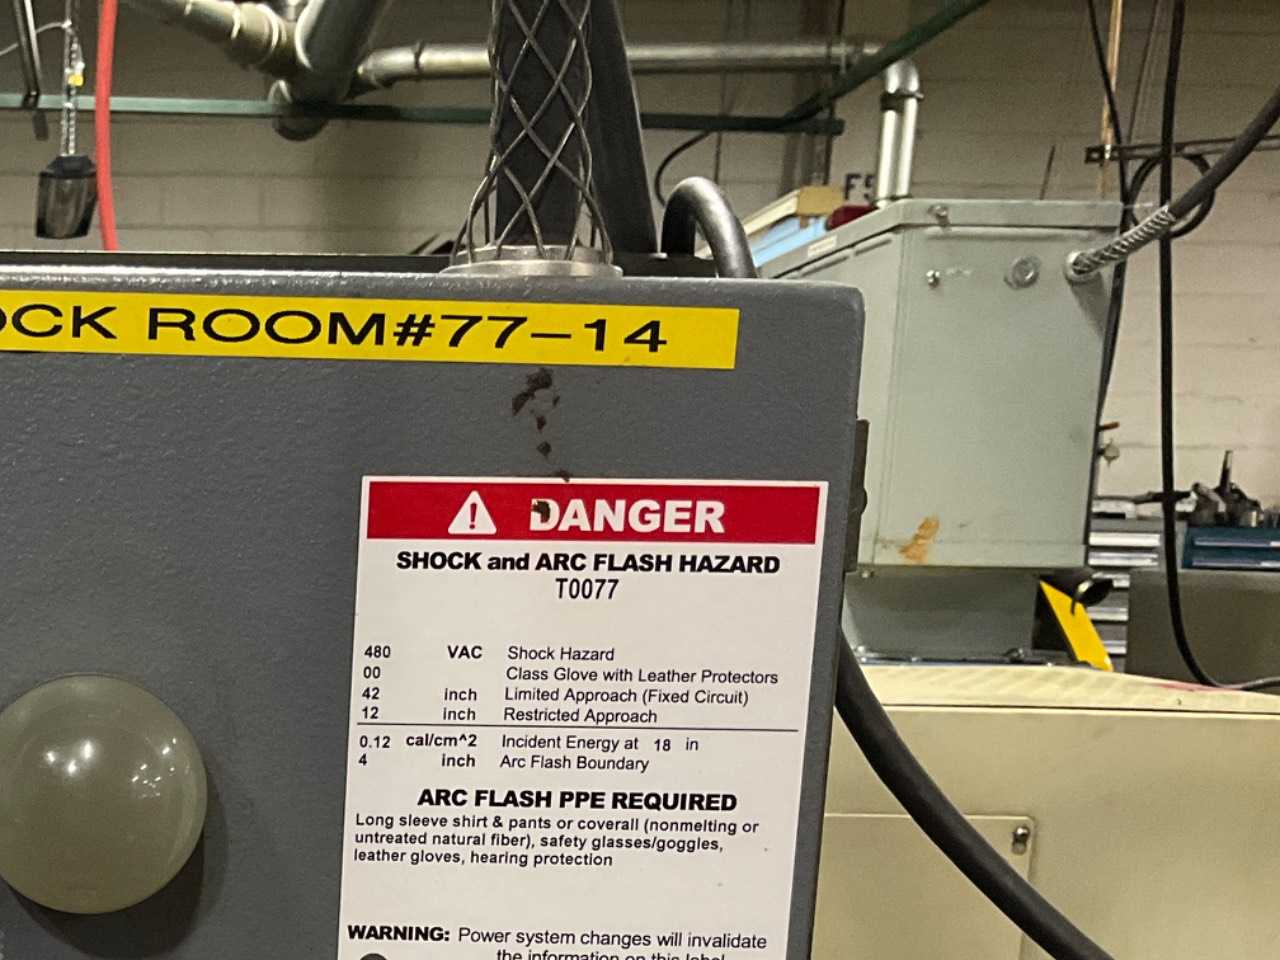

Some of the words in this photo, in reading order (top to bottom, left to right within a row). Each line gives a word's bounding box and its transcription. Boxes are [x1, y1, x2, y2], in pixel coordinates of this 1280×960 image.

[148, 306, 667, 353] ROOM#77-14
[530, 498, 725, 533] DANGER
[397, 551, 482, 570] SHOCK
[488, 553, 529, 570] and
[535, 553, 586, 571] ARC
[593, 554, 672, 572] FLASH
[679, 555, 780, 573] HAZARD
[556, 578, 619, 599] T0077
[364, 645, 391, 659] 480
[447, 645, 482, 659] VAC
[508, 646, 555, 660] Shock
[560, 647, 615, 661] Hazard
[363, 666, 381, 679] 00
[506, 667, 548, 680] Class
[554, 667, 598, 681] Glove
[603, 669, 632, 681] with
[639, 669, 696, 683] Leather
[701, 670, 778, 684] Protectors
[362, 687, 380, 700] 42
[444, 688, 477, 701] inch
[505, 688, 559, 701] Limited
[564, 688, 636, 704] Approach
[642, 689, 689, 705] (Fixed
[695, 690, 748, 706] Circuit)
[362, 707, 379, 719] 12
[443, 707, 476, 720] inch
[504, 707, 579, 721] Restricted
[584, 709, 657, 724] Approach
[359, 736, 390, 748] 0.12
[406, 733, 477, 747] cal/cm^2
[502, 735, 561, 748] Incident
[566, 736, 619, 752] Energy
[624, 738, 638, 750] at
[654, 739, 671, 751] 18
[686, 738, 699, 750] in
[358, 754, 367, 766] 4
[441, 754, 475, 767] inch
[500, 755, 526, 768] Arc
[531, 755, 571, 769] Flash
[577, 756, 649, 773] Boundary
[418, 789, 467, 806] ARC
[475, 790, 552, 808] FLASH
[559, 791, 606, 809] PPE
[612, 792, 737, 811] REQUIRED
[356, 813, 394, 829] Long
[399, 814, 447, 827] sleeve
[453, 815, 487, 827] shirt
[493, 816, 503, 827] &
[509, 816, 551, 831] pants
[557, 818, 573, 829] or
[577, 818, 639, 831] coverall
[644, 819, 737, 835] (nonmelting
[742, 822, 759, 833] or
[355, 832, 427, 844] untreated
[432, 833, 486, 845] natural
[491, 834, 535, 848] fiber),
[540, 835, 586, 850] safety
[592, 836, 723, 852] glasses/goggles,
[354, 850, 406, 861] leather
[411, 850, 465, 865] gloves,
[470, 851, 528, 867] hearing
[533, 853, 612, 867] protection
[348, 925, 450, 941] WARNING:
[458, 928, 511, 943] Power
[516, 930, 575, 947] system
[580, 932, 651, 948] changes
[657, 933, 682, 947] will
[688, 933, 767, 949] invalidate
